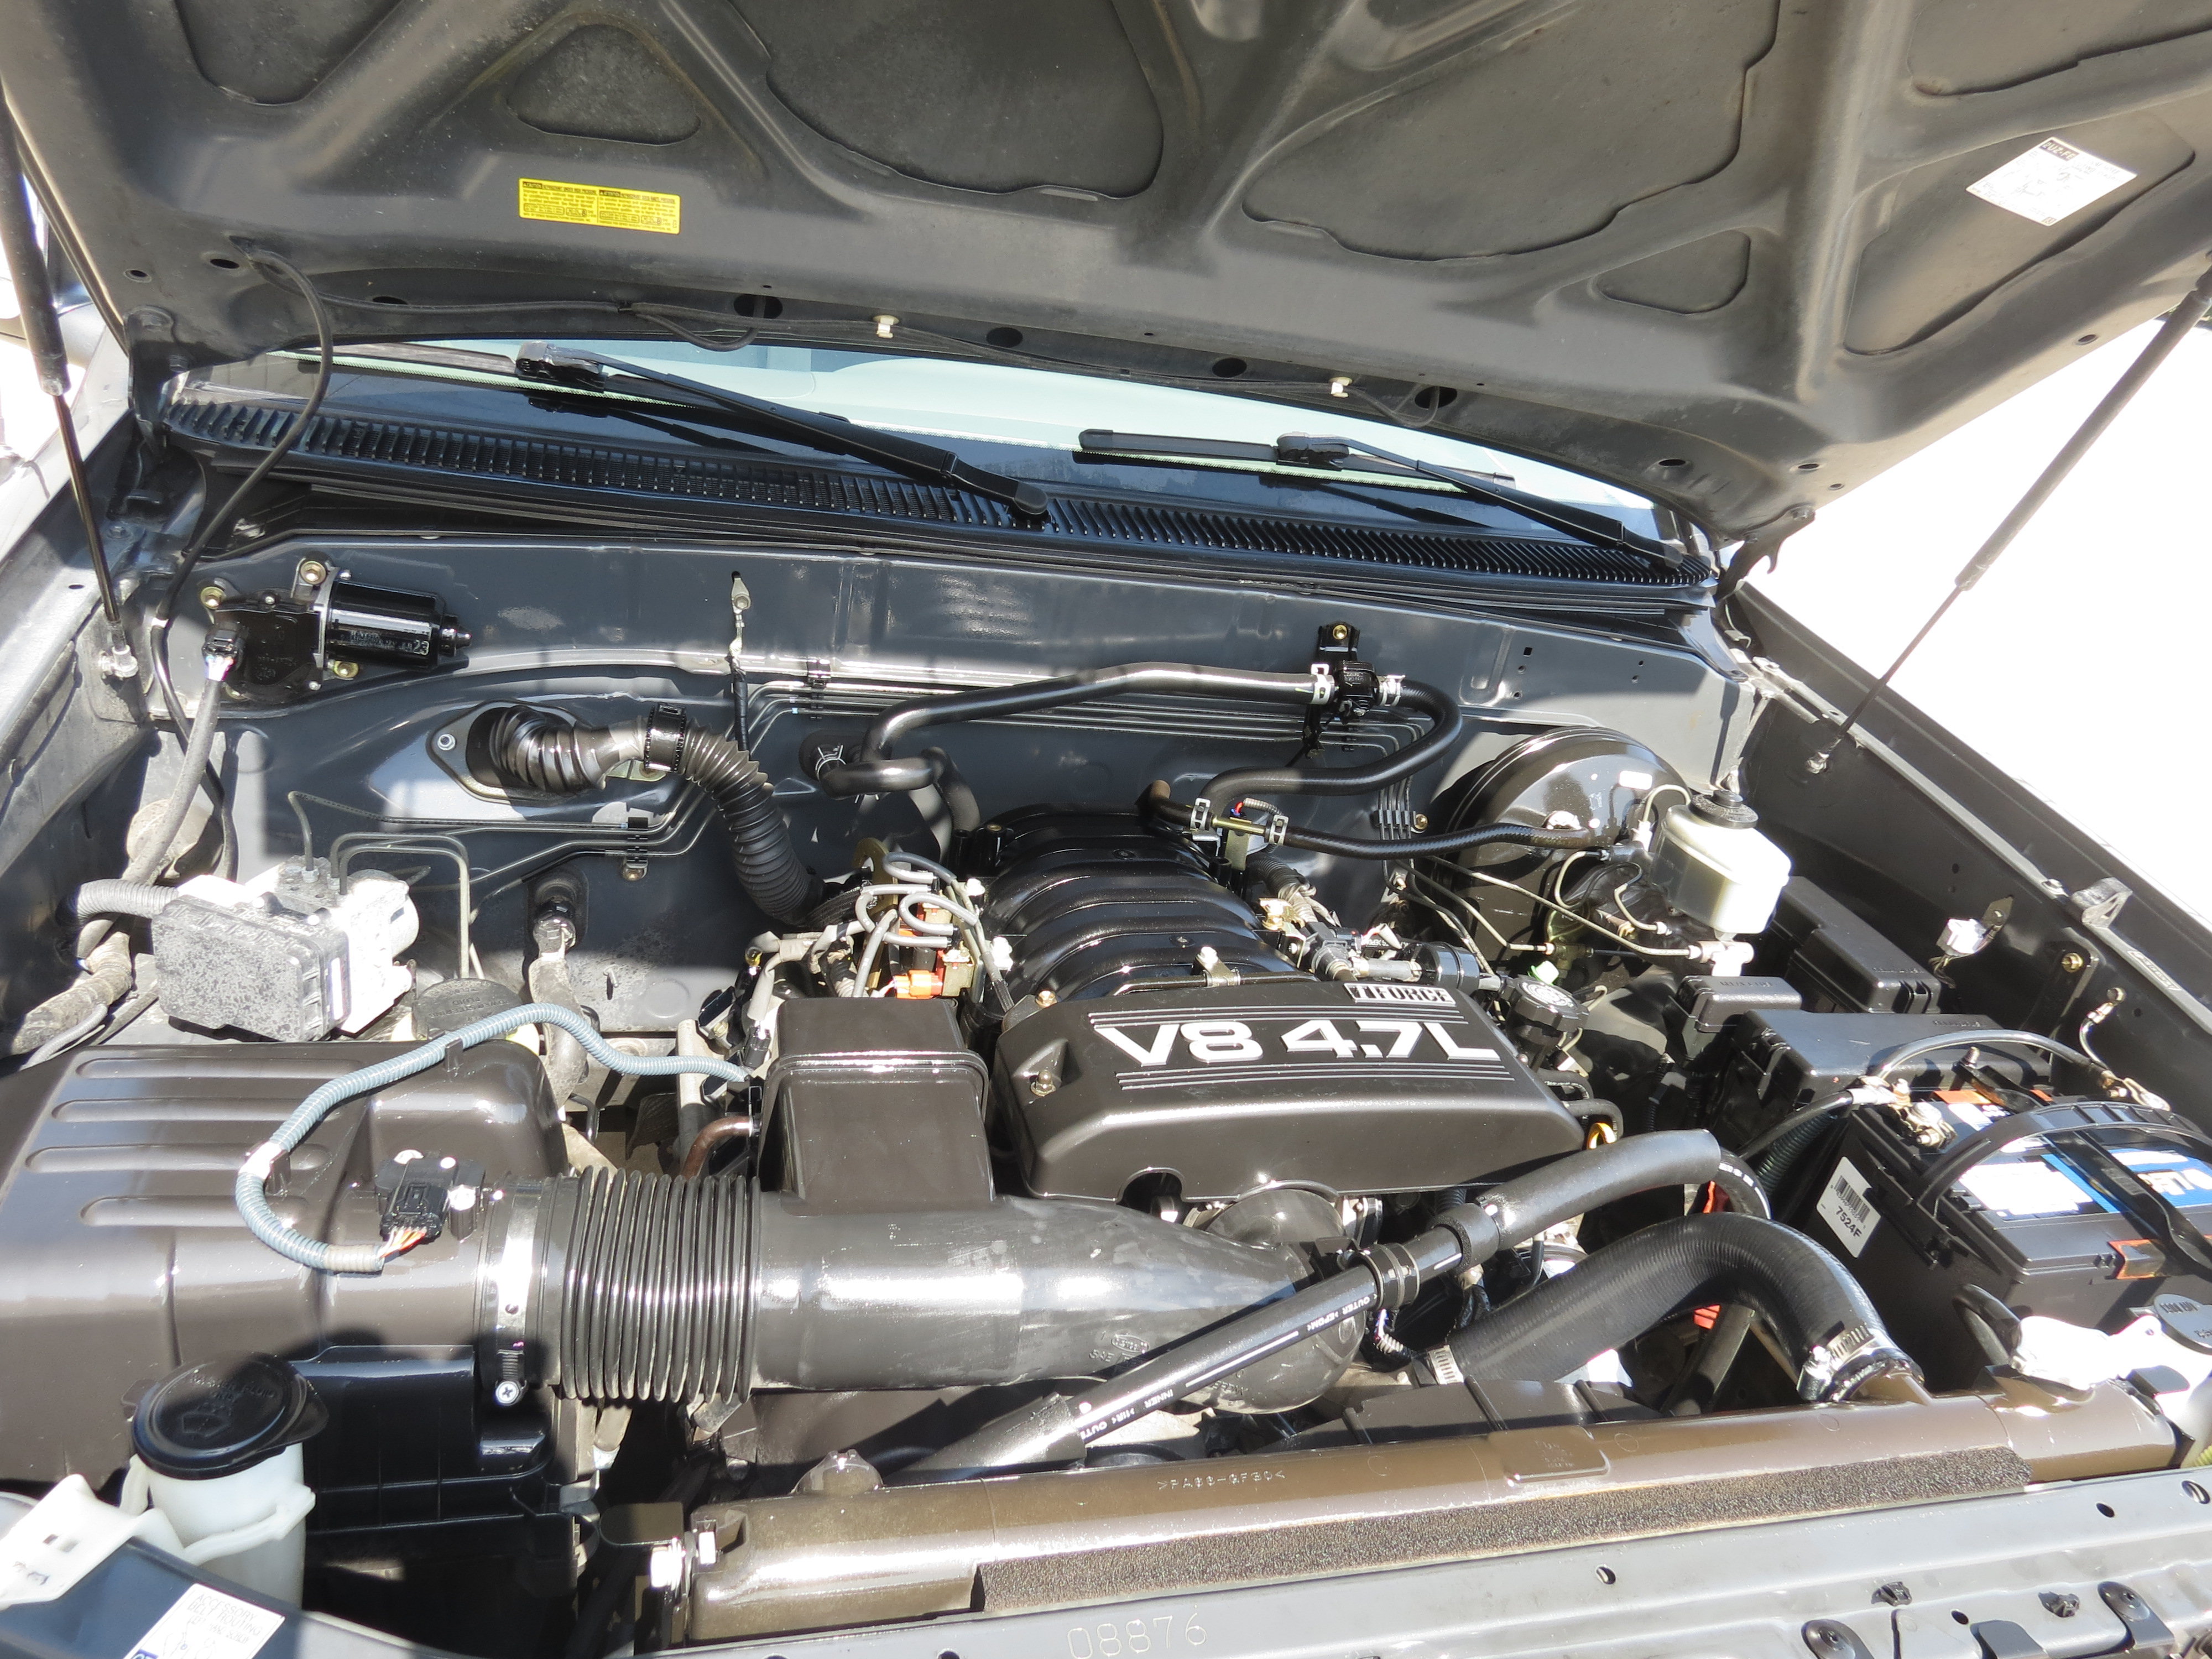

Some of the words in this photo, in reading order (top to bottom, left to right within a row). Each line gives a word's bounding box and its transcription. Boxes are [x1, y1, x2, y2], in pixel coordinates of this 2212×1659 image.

[1093, 1020, 1264, 1067] V8
[1281, 1019, 1501, 1062] 4.7L
[1835, 1205, 1863, 1237] 7524F
[1342, 1296, 1370, 1315] OUTER
[1144, 1389, 1174, 1408] INNER
[1067, 1612, 1207, 1659] 08876
